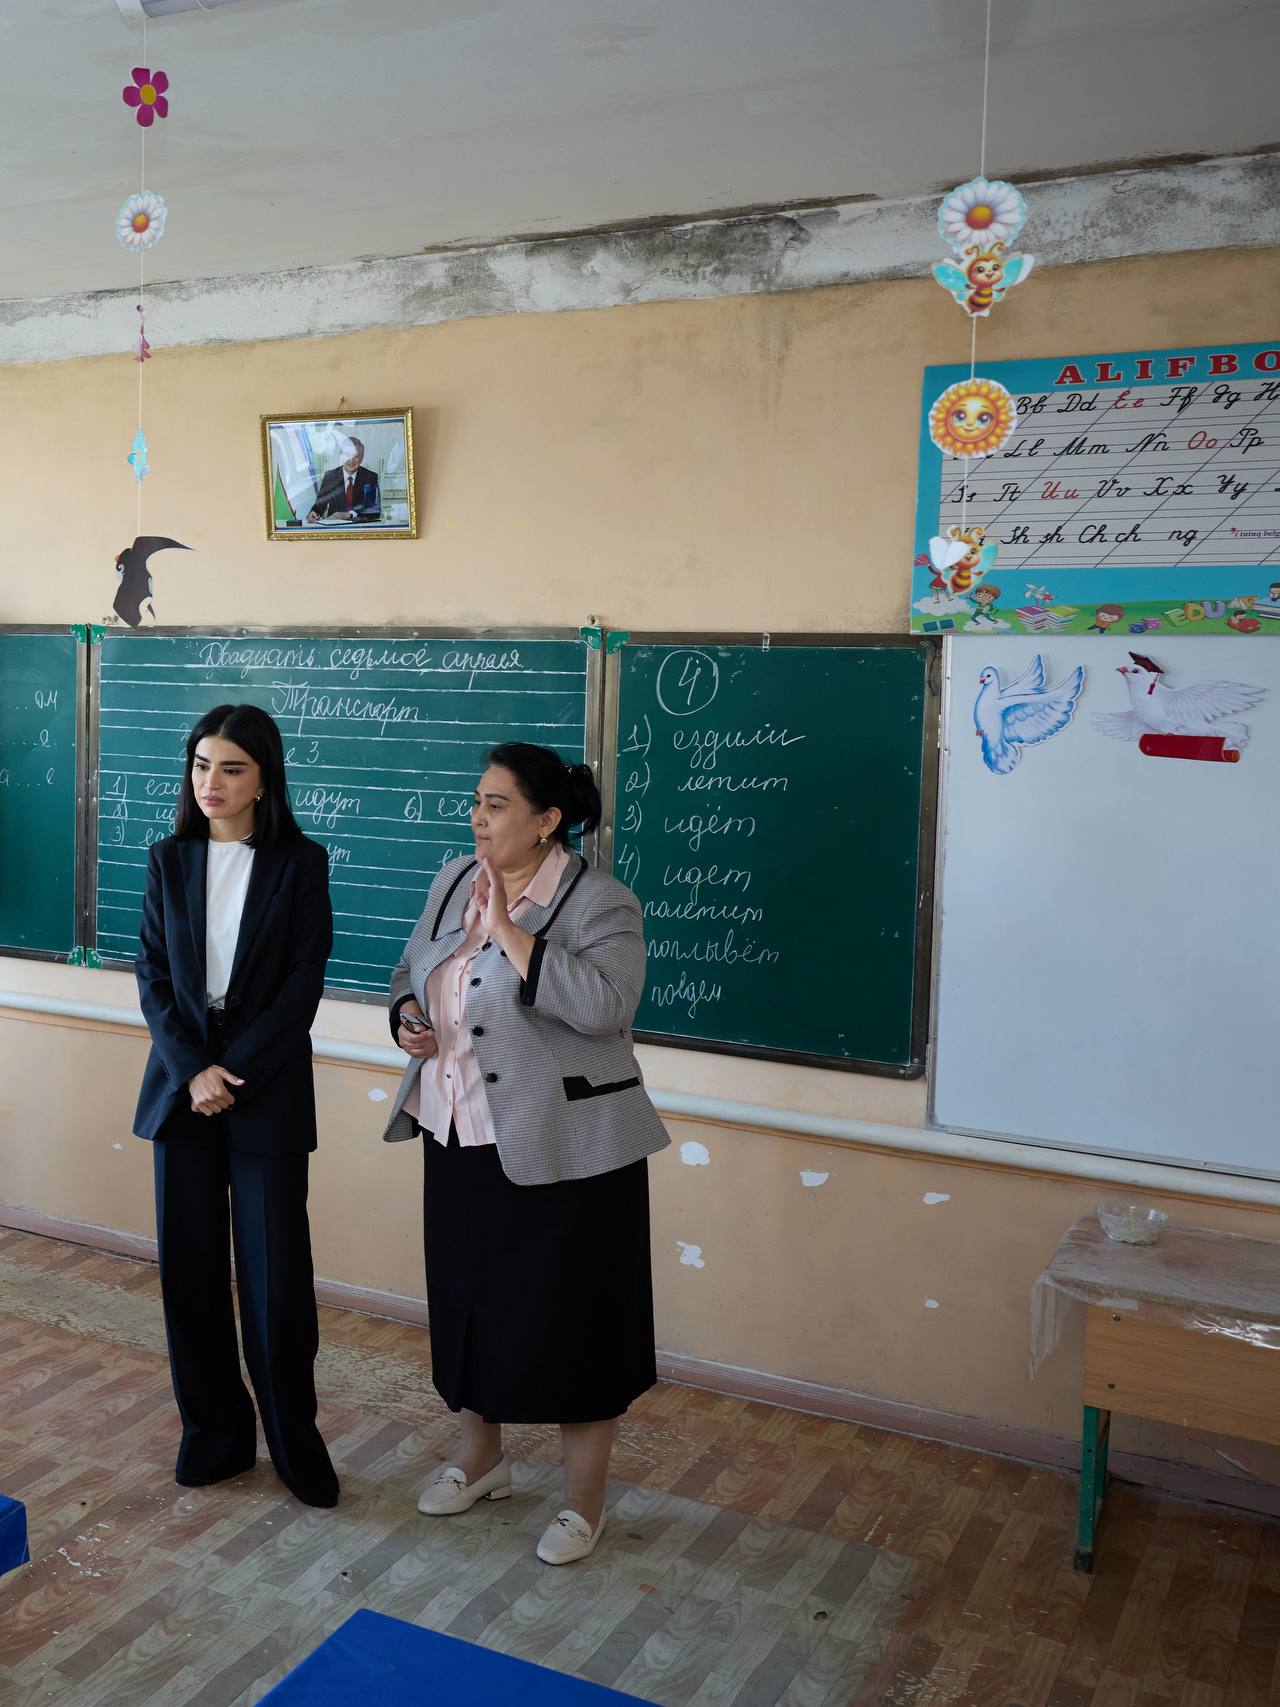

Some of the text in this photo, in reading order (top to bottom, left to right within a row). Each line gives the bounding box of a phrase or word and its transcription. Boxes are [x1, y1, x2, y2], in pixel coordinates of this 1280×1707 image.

[1057, 393, 1099, 413] Dd
[1160, 387, 1198, 413] Ff
[1126, 433, 1170, 452] Nn
[1188, 430, 1218, 450] Oo
[1229, 428, 1264, 454] Pp
[993, 483, 1021, 502] Tt
[1097, 479, 1131, 498] Vv
[1217, 474, 1249, 500] Yy
[1168, 529, 1198, 546] ng
[295, 788, 361, 829] идут
[621, 800, 642, 834] 3)
